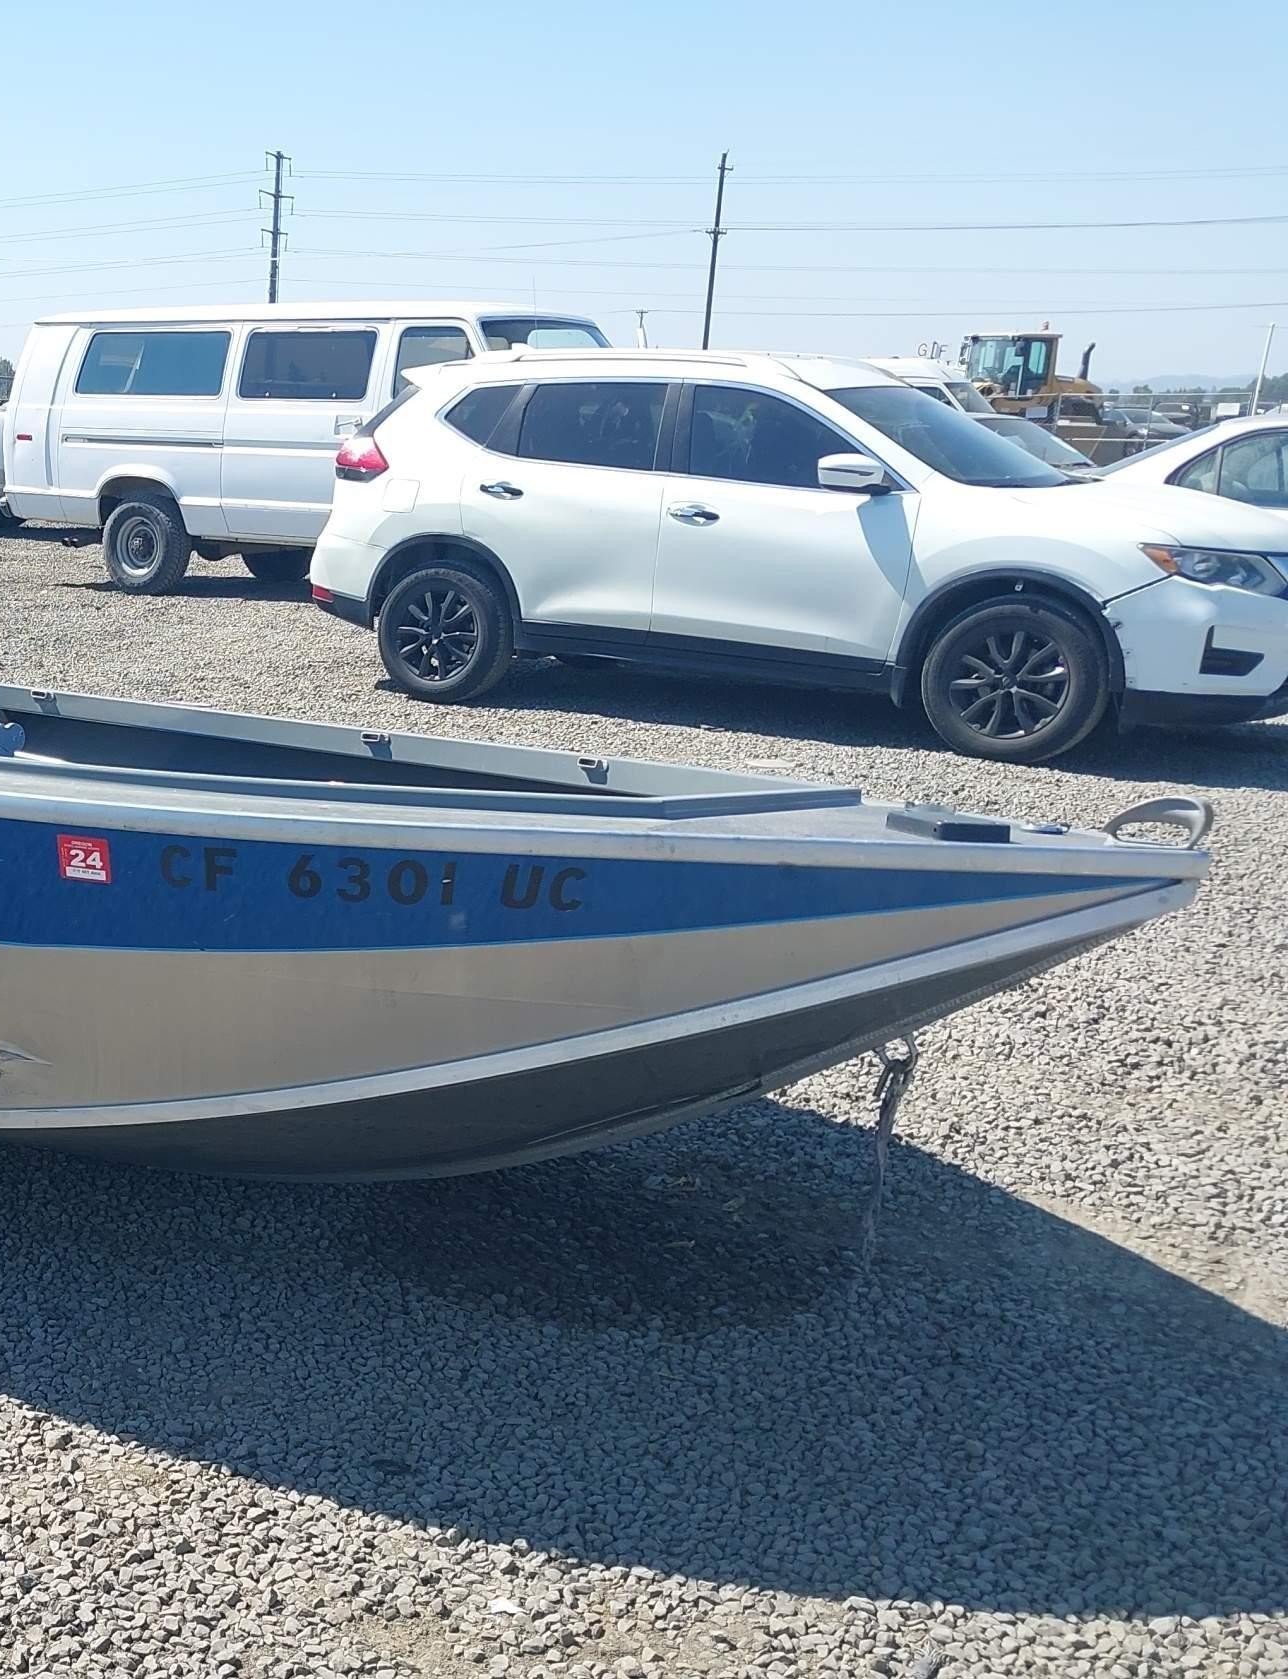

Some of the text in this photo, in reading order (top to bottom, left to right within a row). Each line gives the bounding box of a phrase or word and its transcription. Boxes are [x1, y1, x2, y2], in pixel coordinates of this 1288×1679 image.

[917, 343, 928, 357] G
[69, 849, 104, 869] 24
[160, 844, 589, 912] CF 6301 UC
